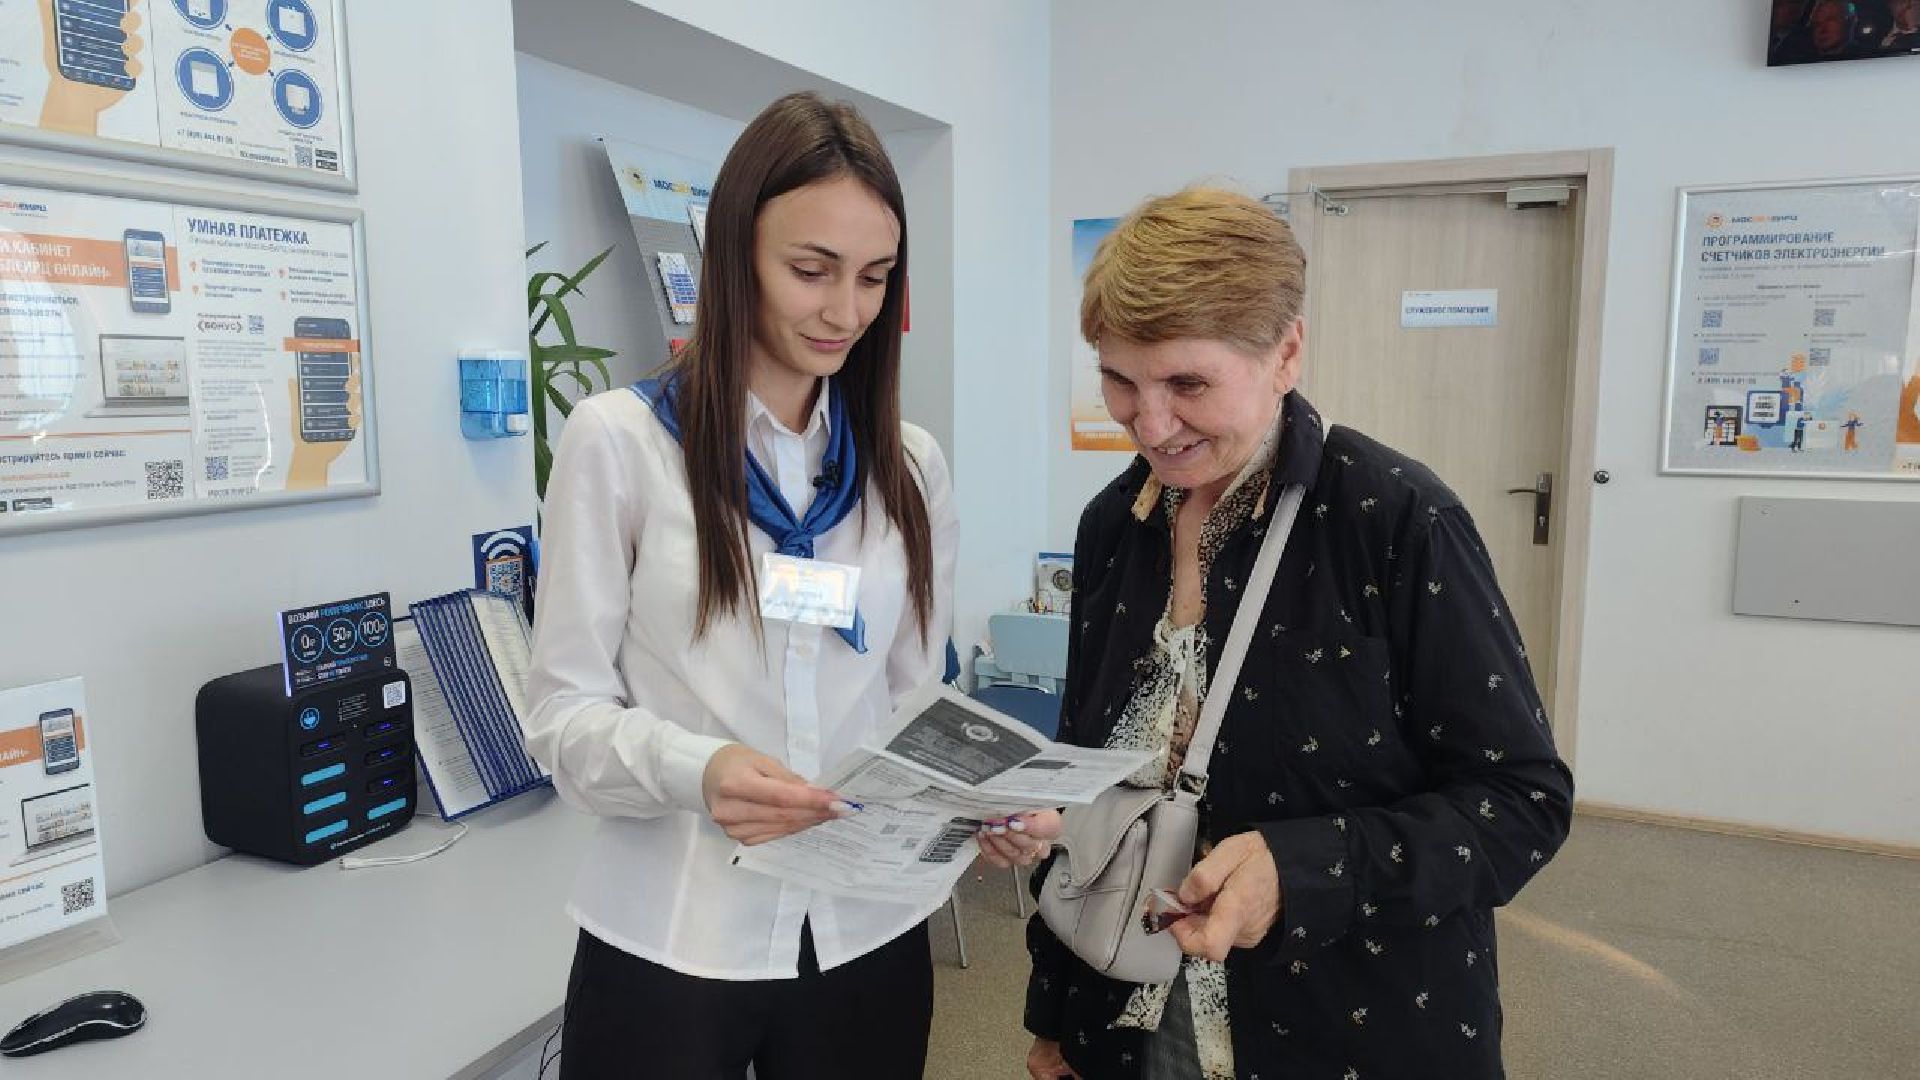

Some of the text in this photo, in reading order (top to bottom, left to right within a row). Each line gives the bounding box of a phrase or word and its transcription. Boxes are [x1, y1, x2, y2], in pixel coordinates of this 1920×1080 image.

[187, 218, 310, 245] УМНАЯ ПЛАТЕЖКА
[1702, 231, 1834, 247] ПРОГРАММИРОВАНИЕ
[1701, 246, 1885, 263] СЧЕТЧИКОВ ЭЛЕКТРОЭНЕРГИИ
